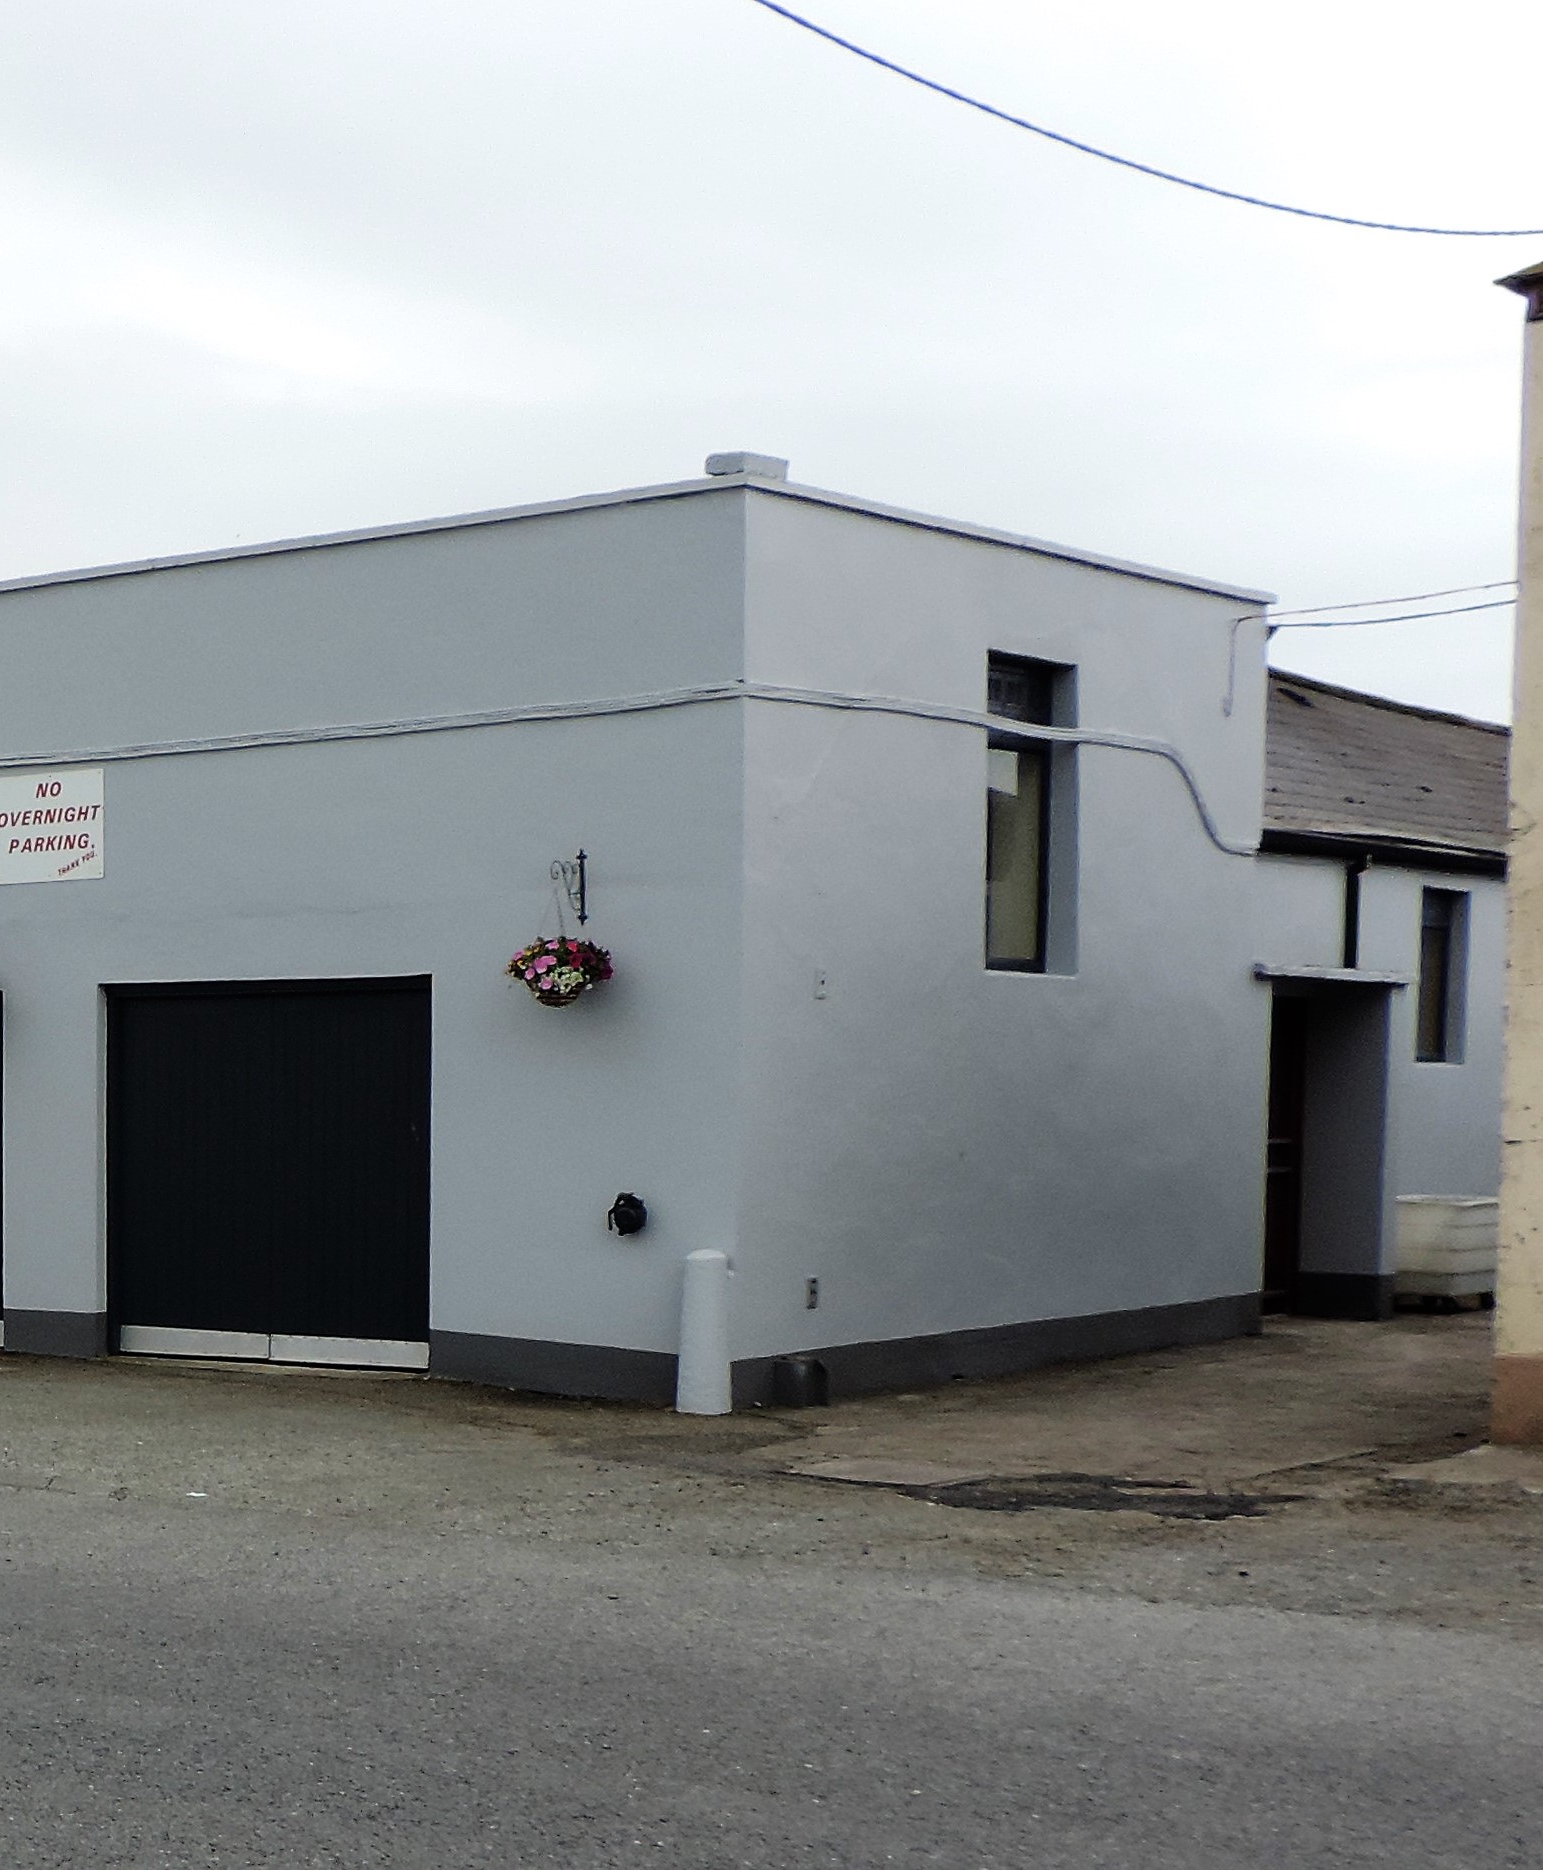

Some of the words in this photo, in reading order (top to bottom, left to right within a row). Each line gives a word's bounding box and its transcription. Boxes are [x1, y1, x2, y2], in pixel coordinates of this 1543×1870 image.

[36, 781, 61, 798] NO
[8, 833, 94, 854] PARKING.
[58, 859, 80, 875] THANK
